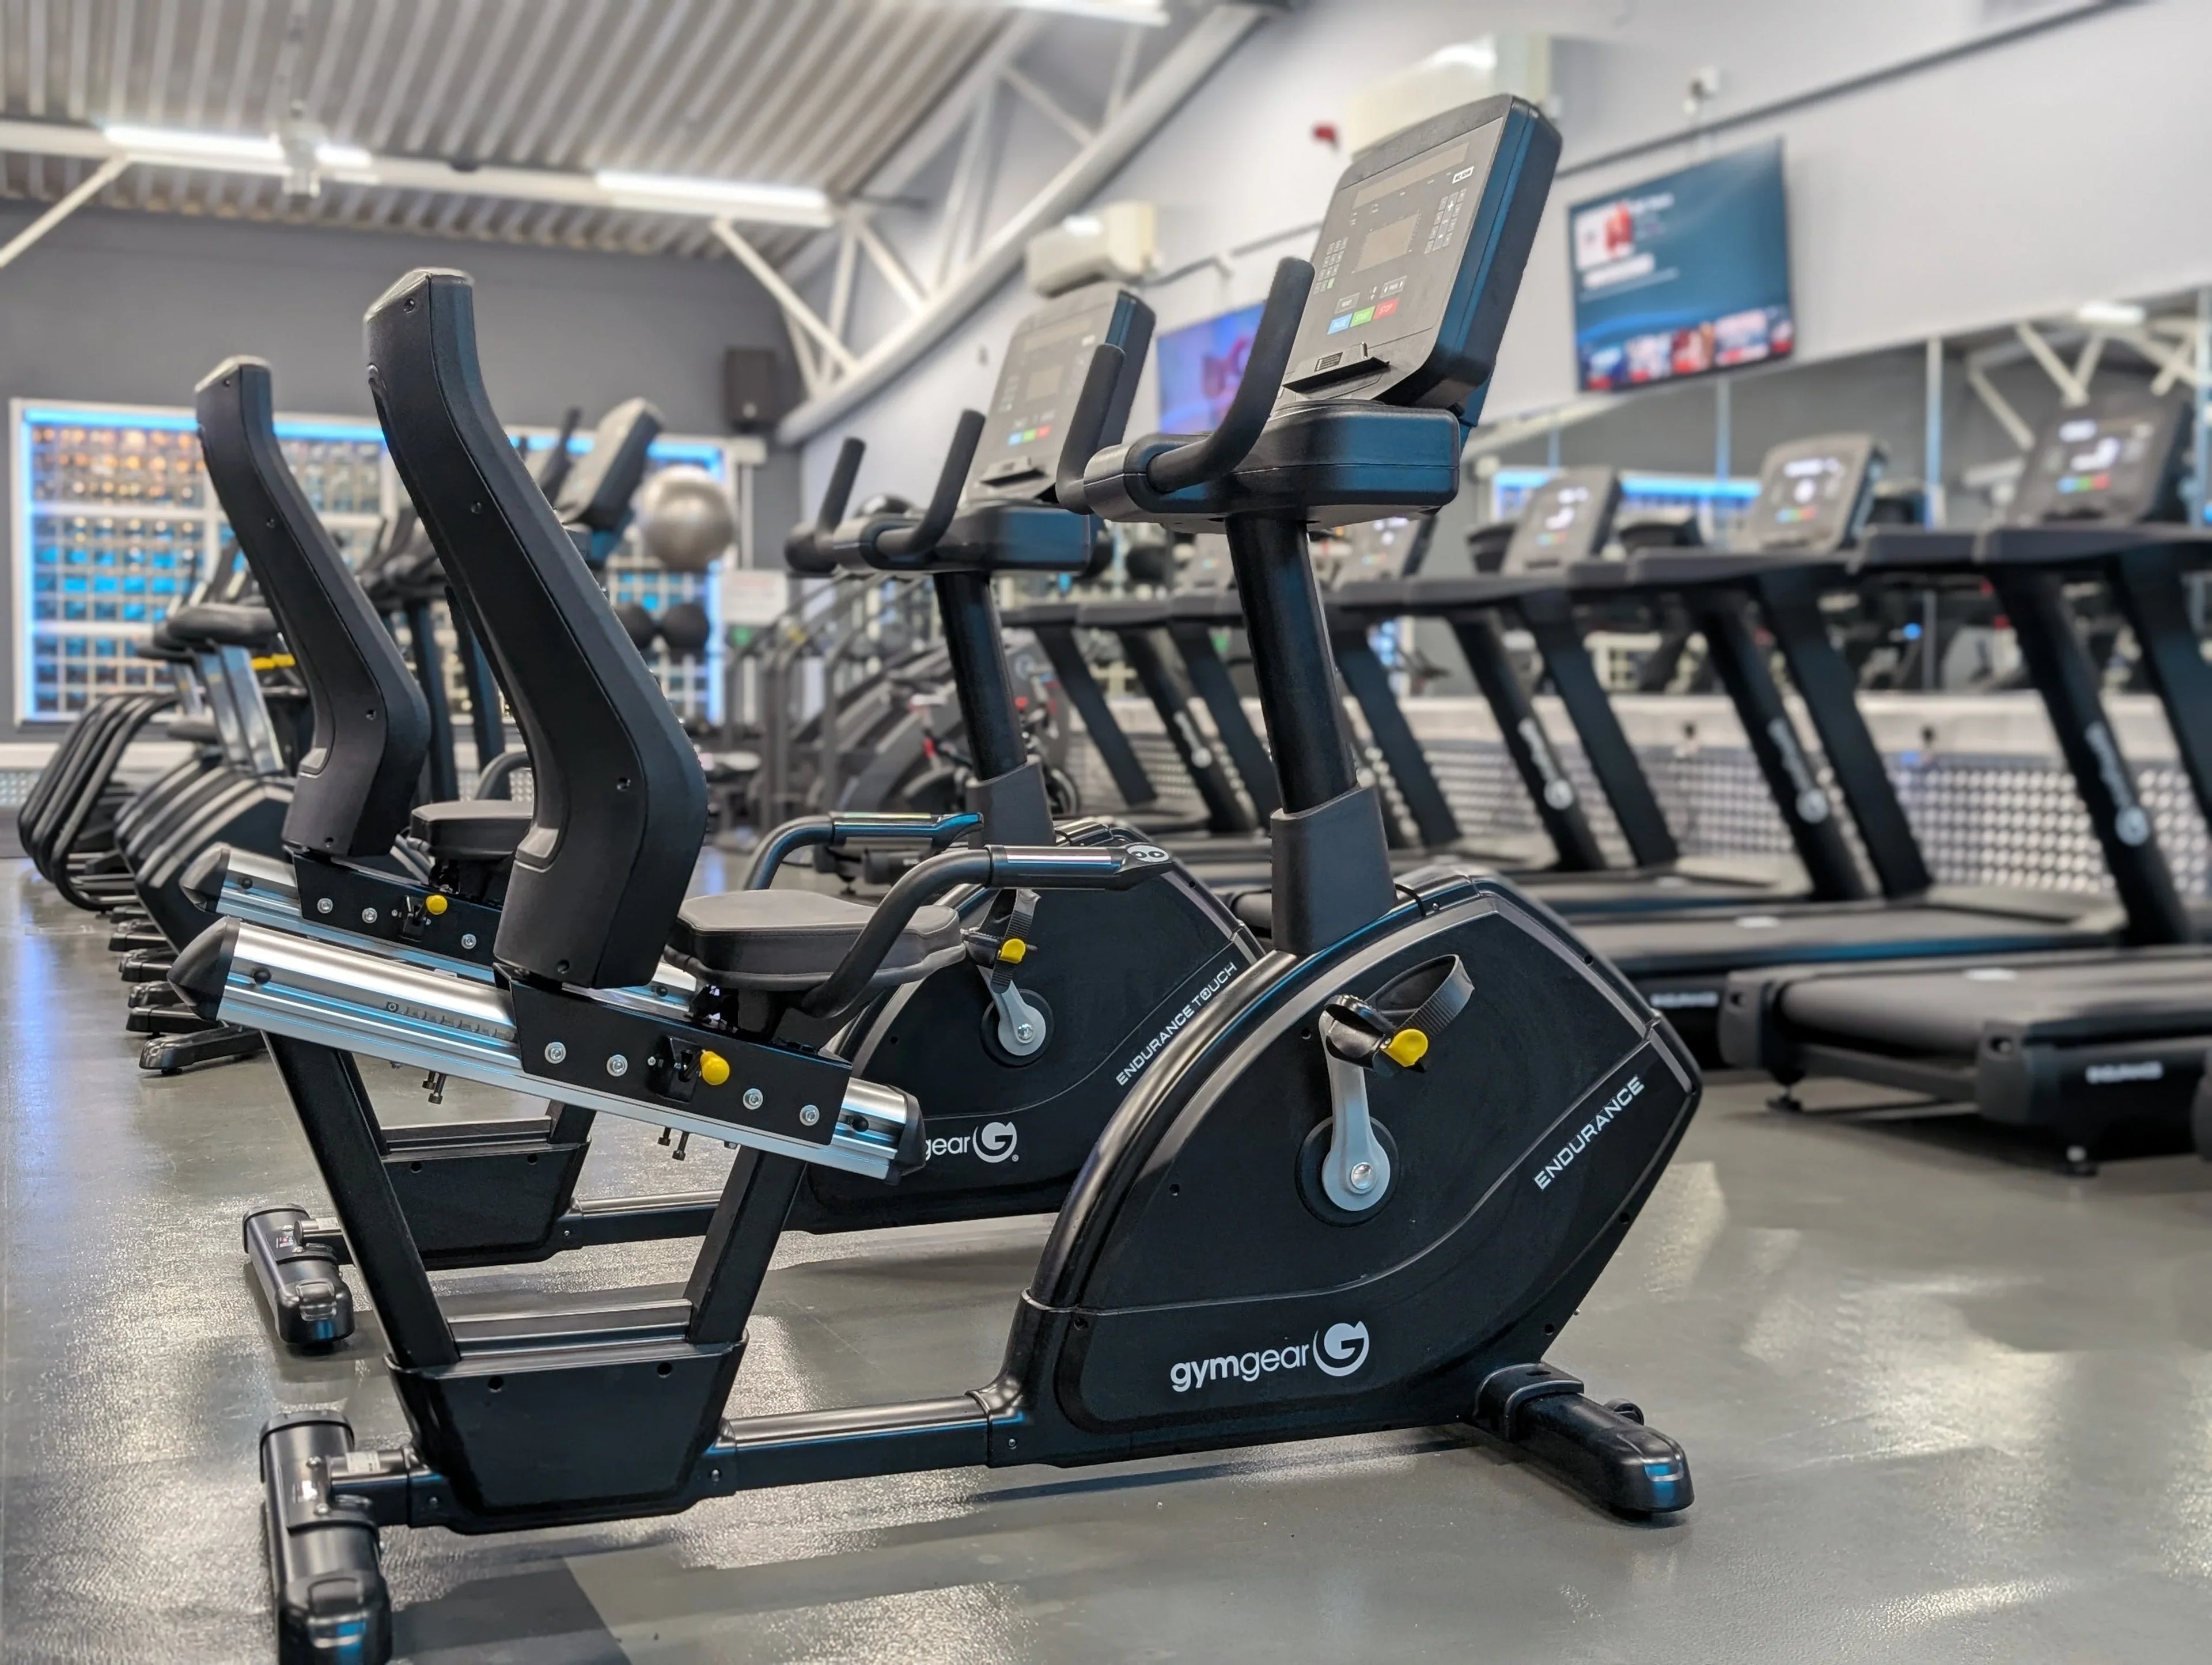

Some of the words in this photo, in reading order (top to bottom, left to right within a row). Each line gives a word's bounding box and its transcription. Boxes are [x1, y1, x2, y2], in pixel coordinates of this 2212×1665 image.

[1116, 1004, 1195, 1086] ENDURANCE
[1192, 962, 1238, 1007] TOUCH
[1534, 1075, 1645, 1190] ENDURANCE
[1170, 1344, 1309, 1392] gymgear
